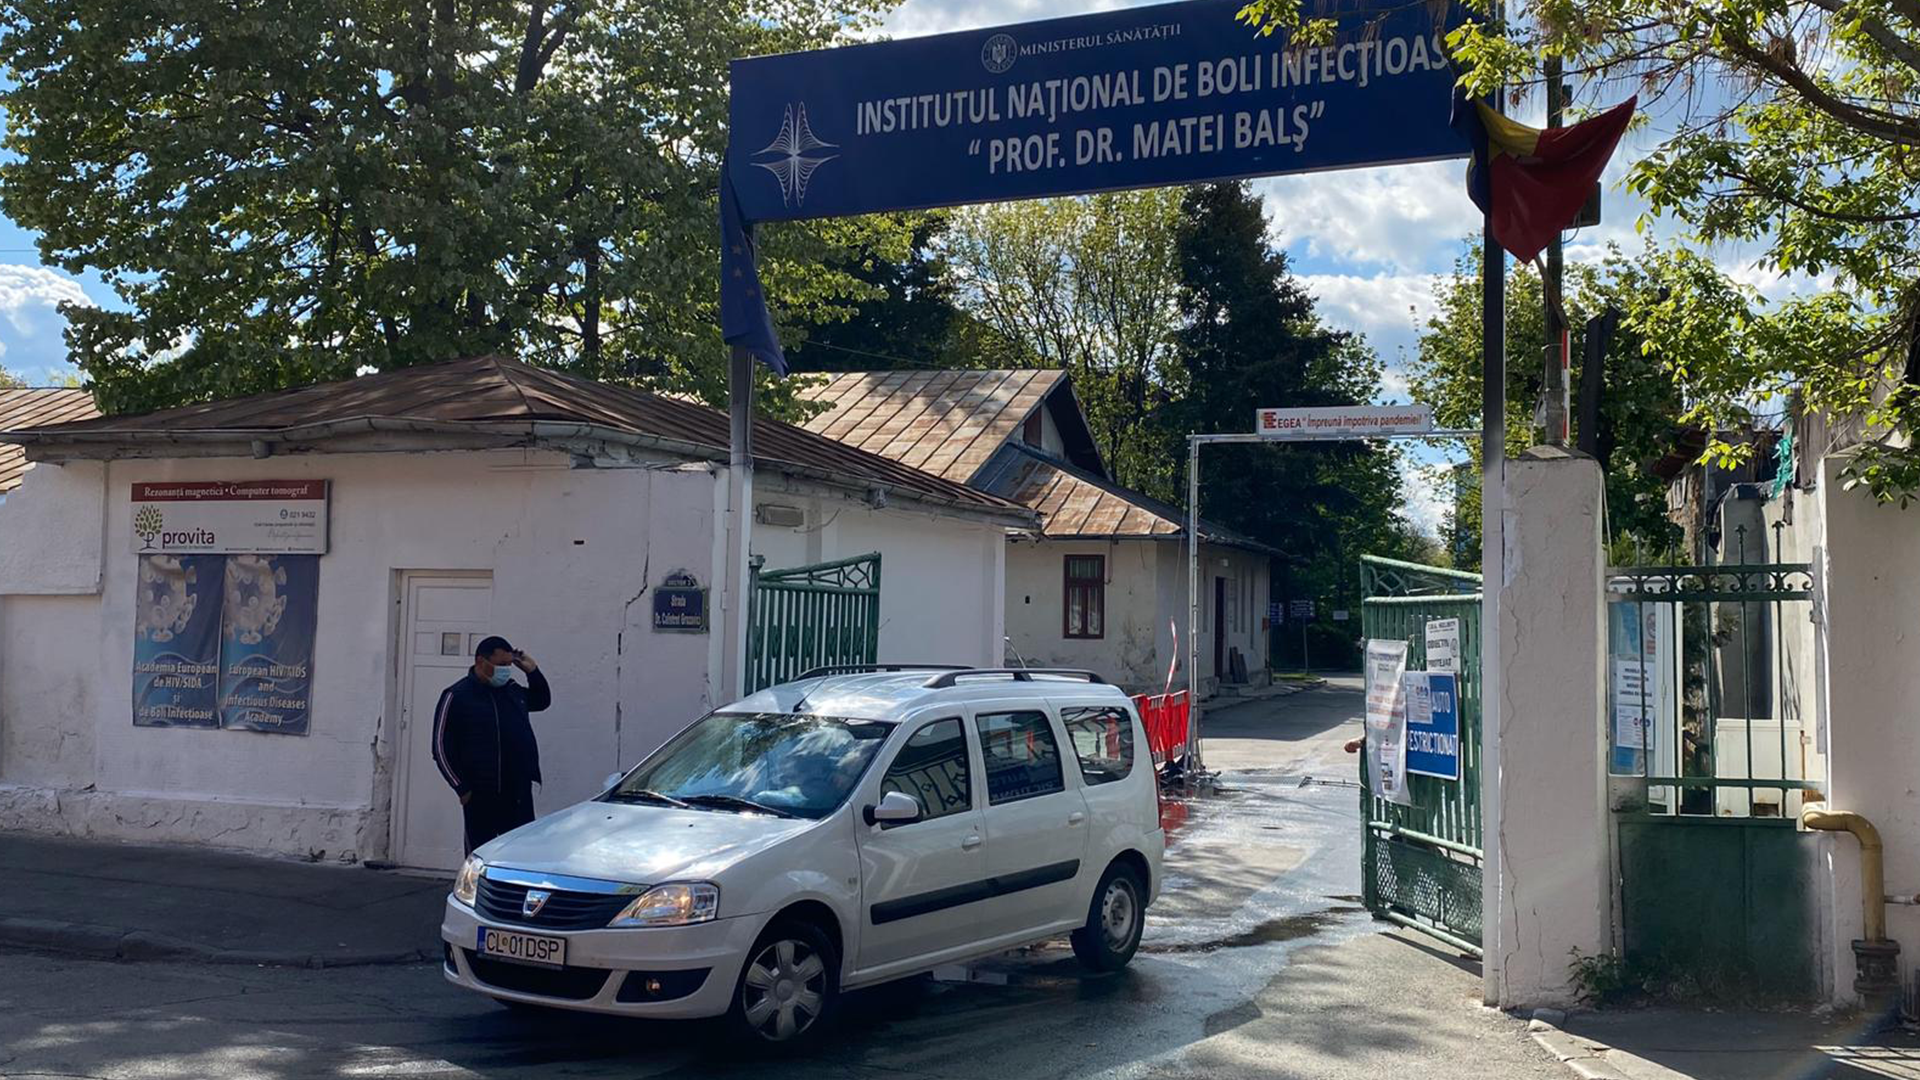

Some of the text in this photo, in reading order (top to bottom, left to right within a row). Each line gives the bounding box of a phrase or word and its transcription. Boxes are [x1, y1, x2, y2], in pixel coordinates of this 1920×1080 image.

[1019, 36, 1103, 56] MINISTERUL
[856, 87, 1001, 136] INSTITUTUL
[1153, 63, 1189, 101] DE
[1197, 54, 1261, 97] BOLI
[1271, 34, 1447, 88] INFECŢIOAS
[989, 132, 1066, 174] PROF.
[1075, 127, 1122, 165] DR.
[1133, 114, 1224, 160] MATEI
[230, 485, 270, 498] Computer
[271, 484, 309, 498] tomograf
[162, 527, 215, 549] provita
[177, 662, 219, 676] European
[228, 663, 268, 677] European
[258, 680, 275, 692] and
[269, 695, 306, 710] Diseases
[244, 710, 283, 727] Academy
